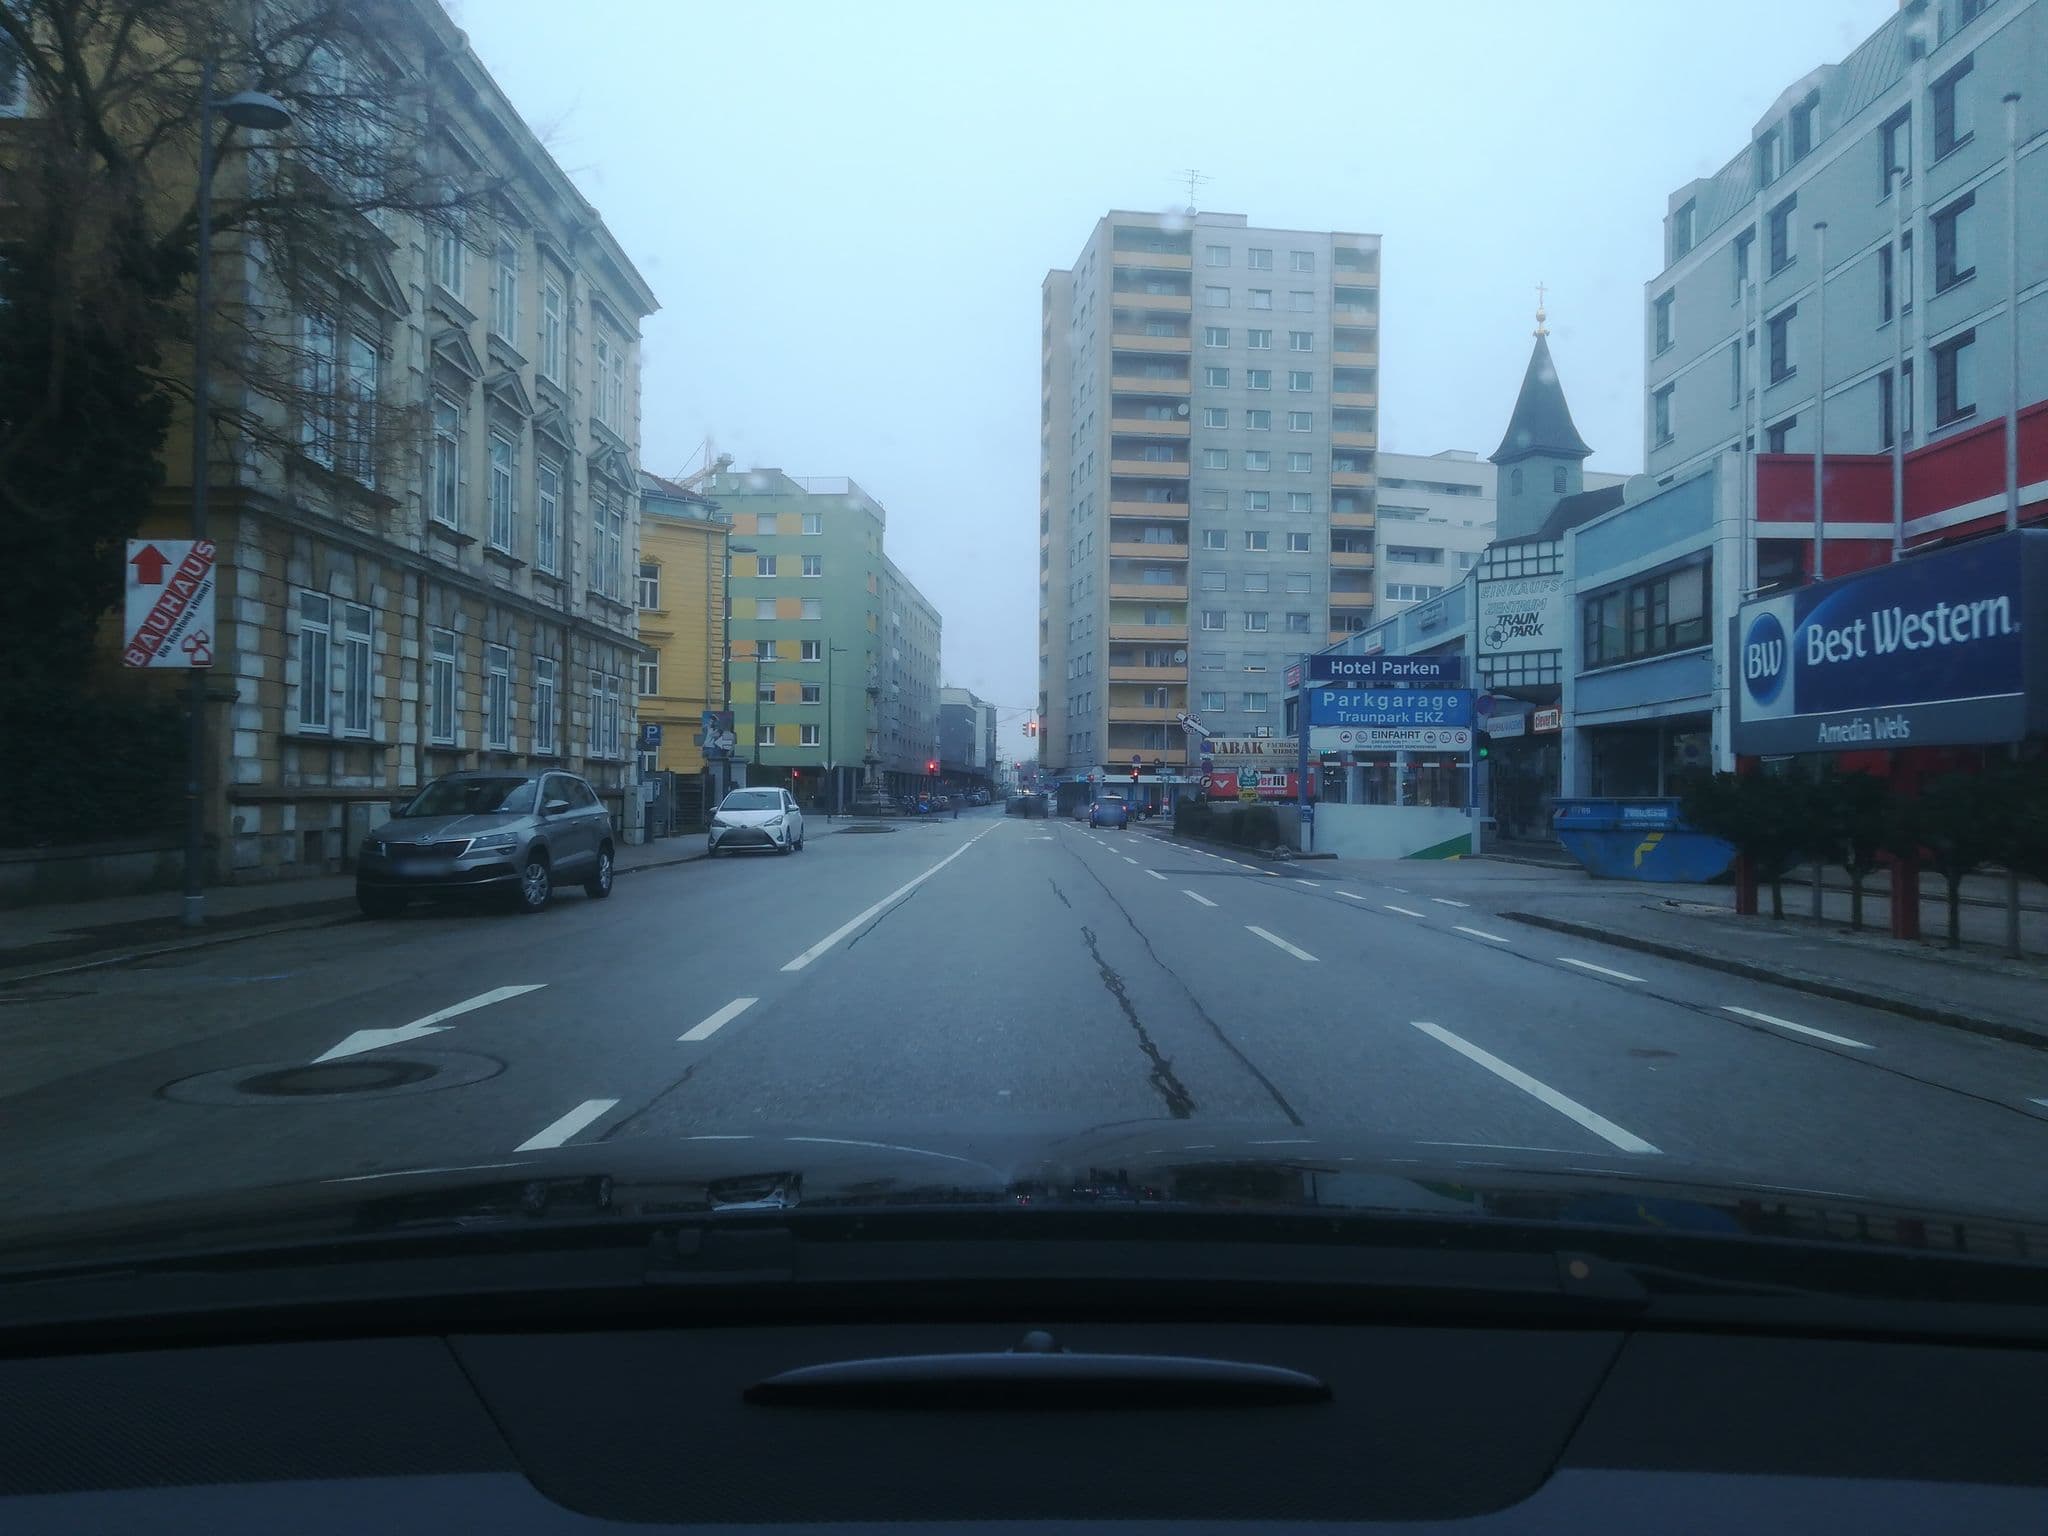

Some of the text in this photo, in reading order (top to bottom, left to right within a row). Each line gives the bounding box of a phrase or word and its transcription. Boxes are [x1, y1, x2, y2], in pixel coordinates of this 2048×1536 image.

[1480, 579, 1561, 599] EINKAUFS
[123, 540, 216, 666] BAUHAUS
[1485, 598, 1548, 616] ZENTRUM
[1497, 612, 1539, 626] TRAUN
[1509, 624, 1545, 637] PARK
[1807, 618, 1867, 666] Best
[1331, 661, 1440, 675] Hotel Parken
[1747, 639, 1782, 679] BW
[1323, 692, 1459, 711] Parkgarage
[1337, 711, 1445, 725] Traunpark EKZ
[1371, 730, 1421, 740] EINFAHRT
[1817, 714, 1911, 743] Amedia Wels
[1210, 741, 1264, 754] TABAK
